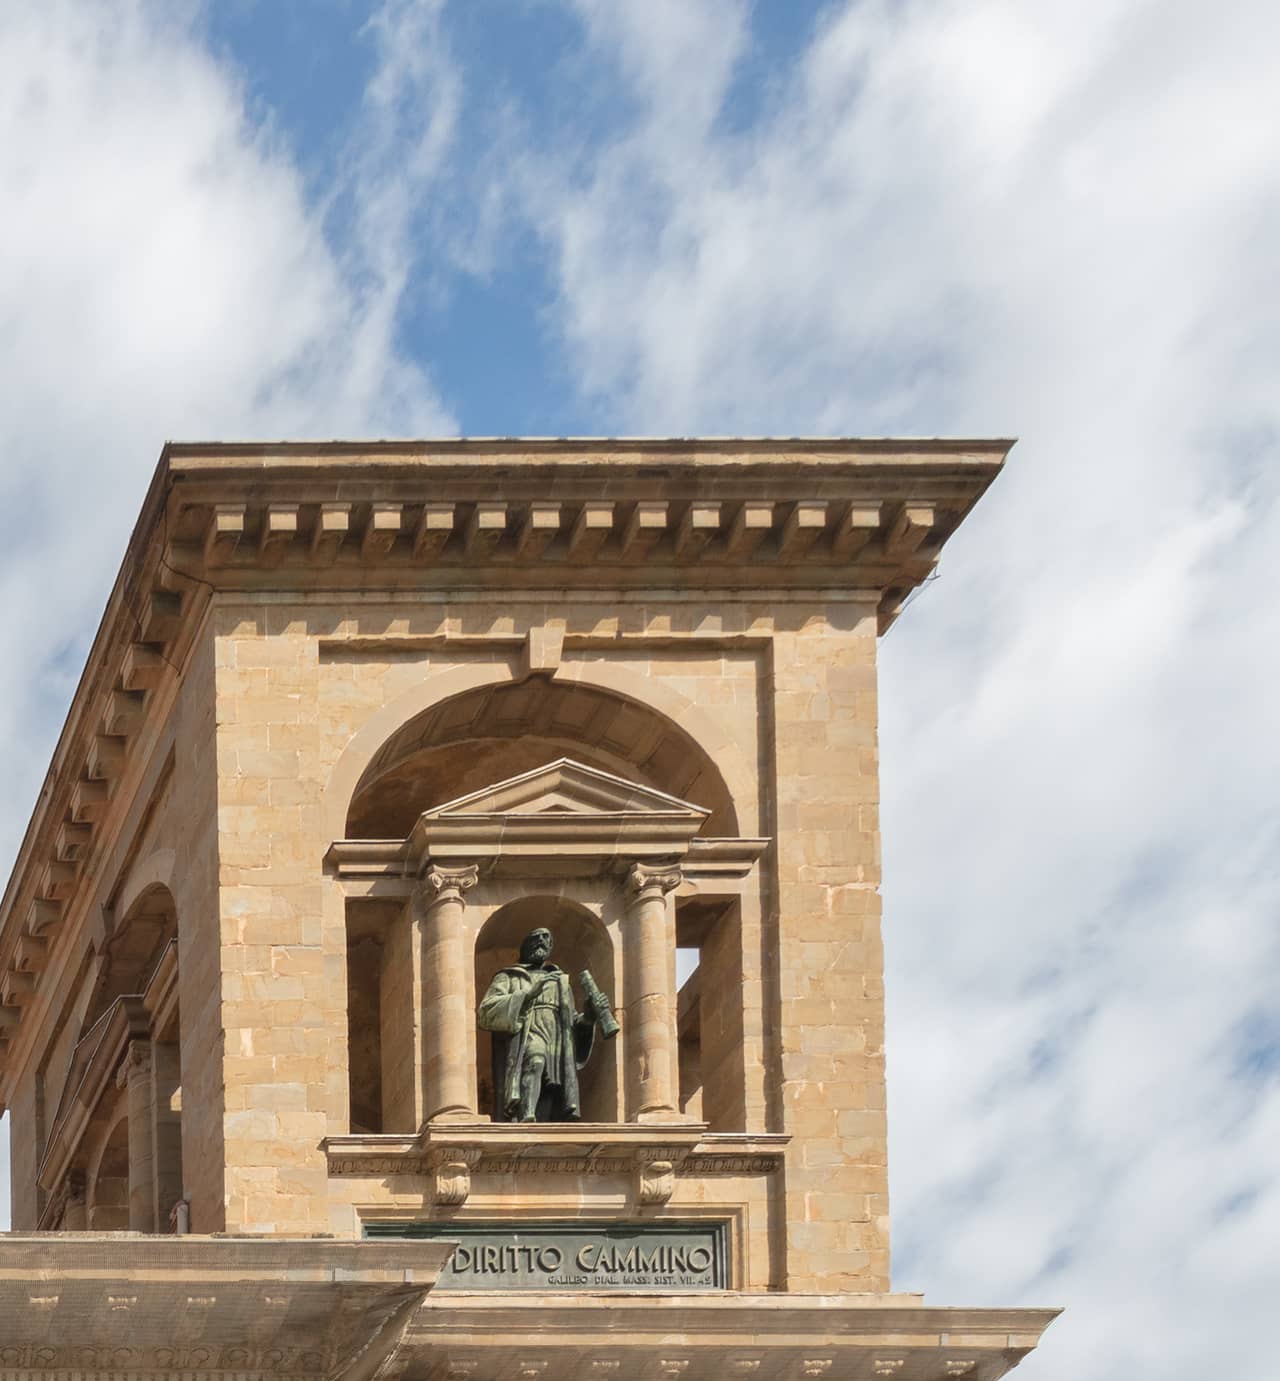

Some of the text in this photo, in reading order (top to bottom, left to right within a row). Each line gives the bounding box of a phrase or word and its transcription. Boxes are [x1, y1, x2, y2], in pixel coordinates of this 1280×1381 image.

[451, 1244, 713, 1274] DIRITTO CAMMINO
[547, 1276, 588, 1285] GALILEO
